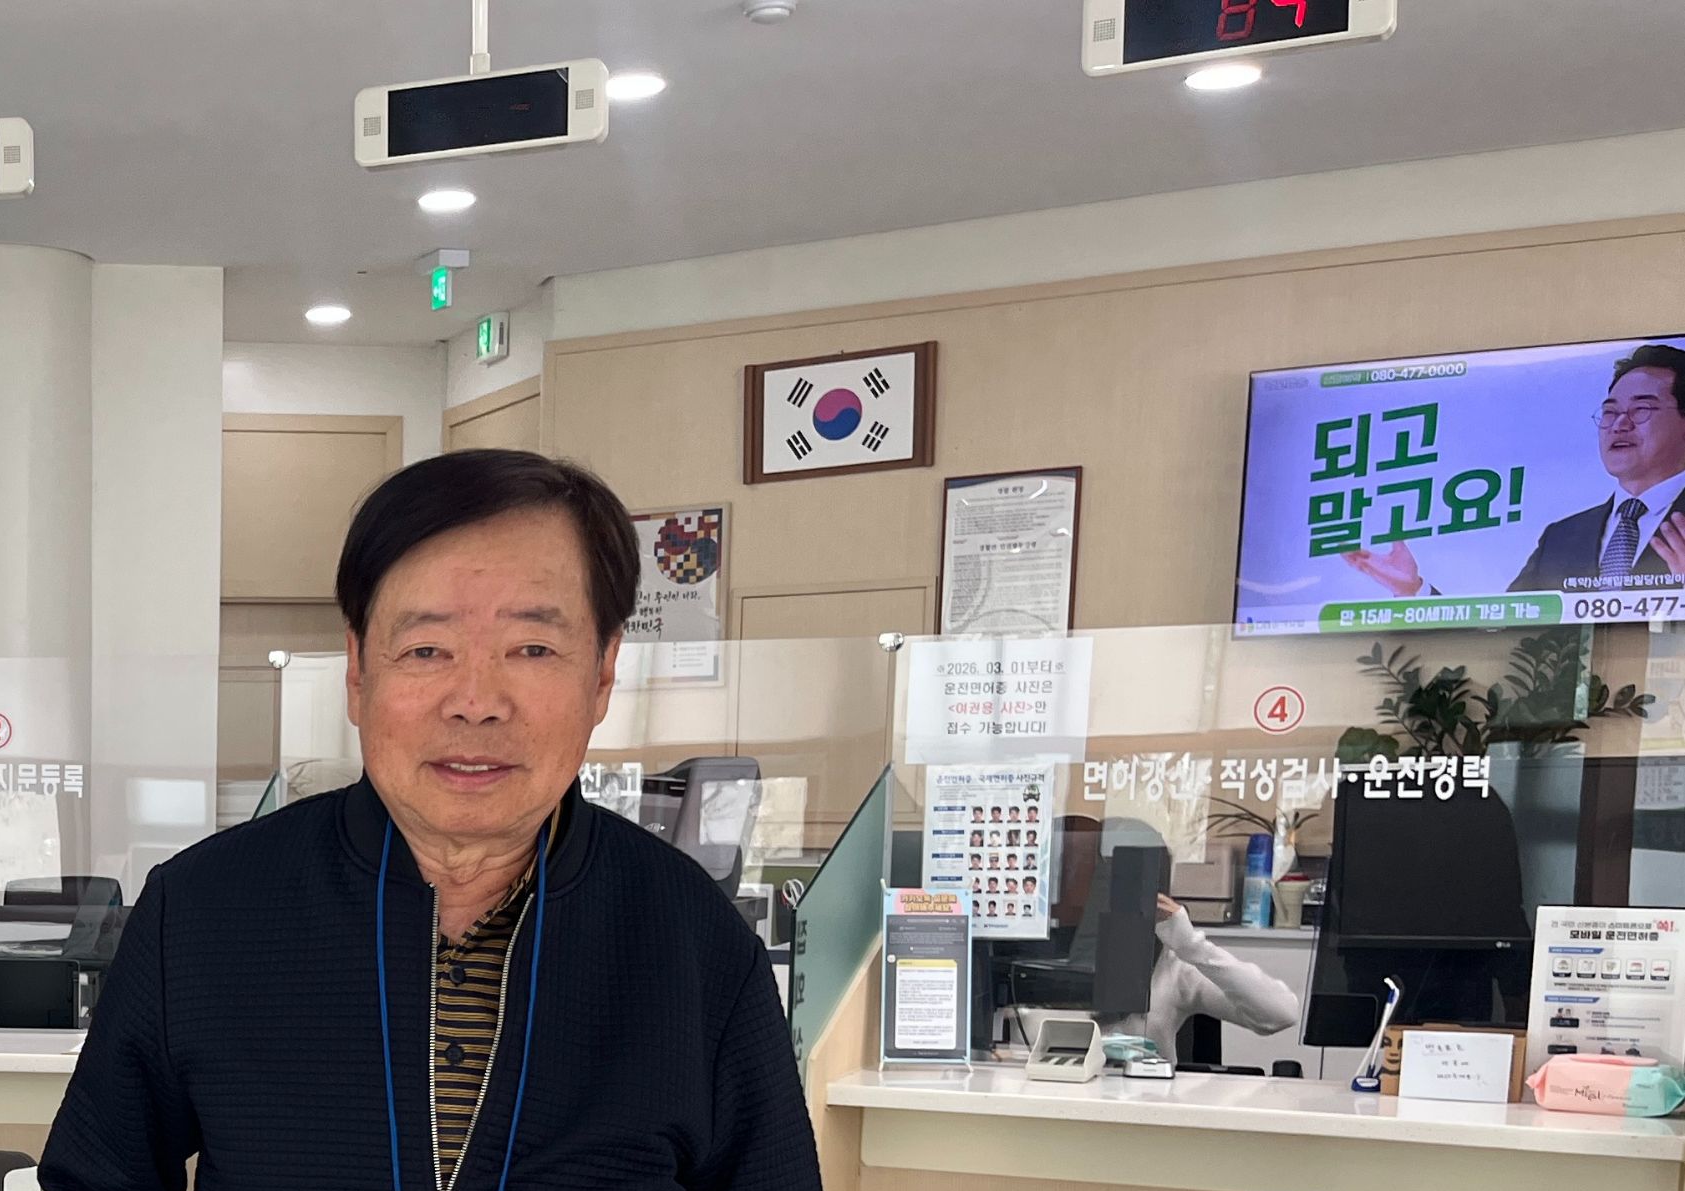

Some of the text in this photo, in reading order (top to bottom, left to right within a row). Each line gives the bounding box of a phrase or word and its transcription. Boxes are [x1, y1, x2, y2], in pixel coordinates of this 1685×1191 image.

[1370, 363, 1464, 382] 080-477-0000
[1309, 402, 1439, 482] 되고
[1308, 466, 1525, 558] 말고요!
[1476, 603, 1505, 620] 가입
[1511, 602, 1541, 618] 가능
[1575, 597, 1685, 618] 080-477-
[986, 661, 1004, 674] 03.
[944, 680, 1053, 696] 운전면허증 사진은
[947, 721, 1046, 735] 접수 가능합니다!
[1569, 930, 1659, 941] 모바일 운전면허증
